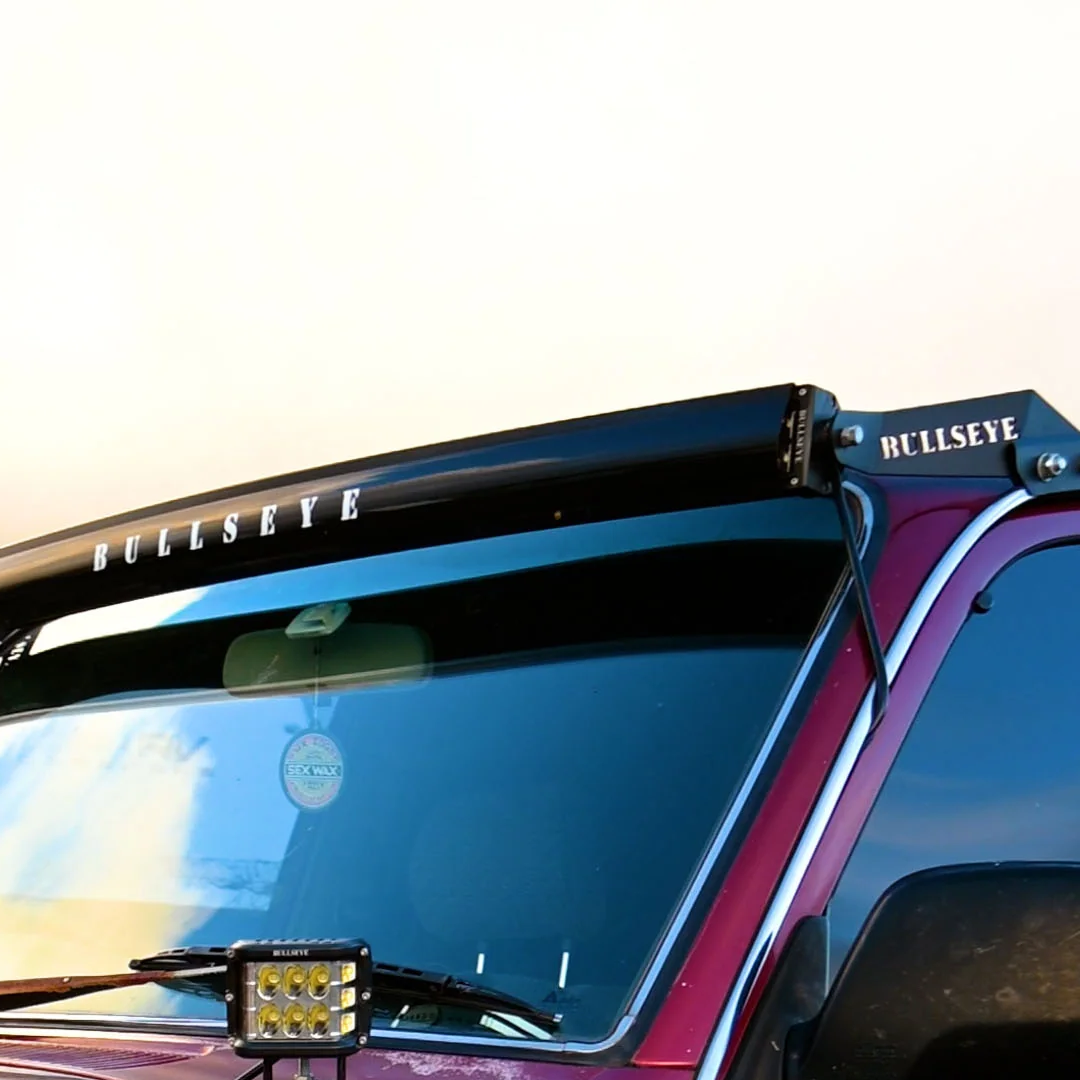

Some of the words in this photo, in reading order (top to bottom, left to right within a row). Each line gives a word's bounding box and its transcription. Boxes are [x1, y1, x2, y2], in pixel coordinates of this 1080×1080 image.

[879, 416, 1019, 460] BULLSEYE
[92, 487, 361, 572] BULLSEYE
[287, 764, 311, 776] SEX
[311, 764, 338, 777] WAX
[272, 949, 310, 957] BULLSEYE
